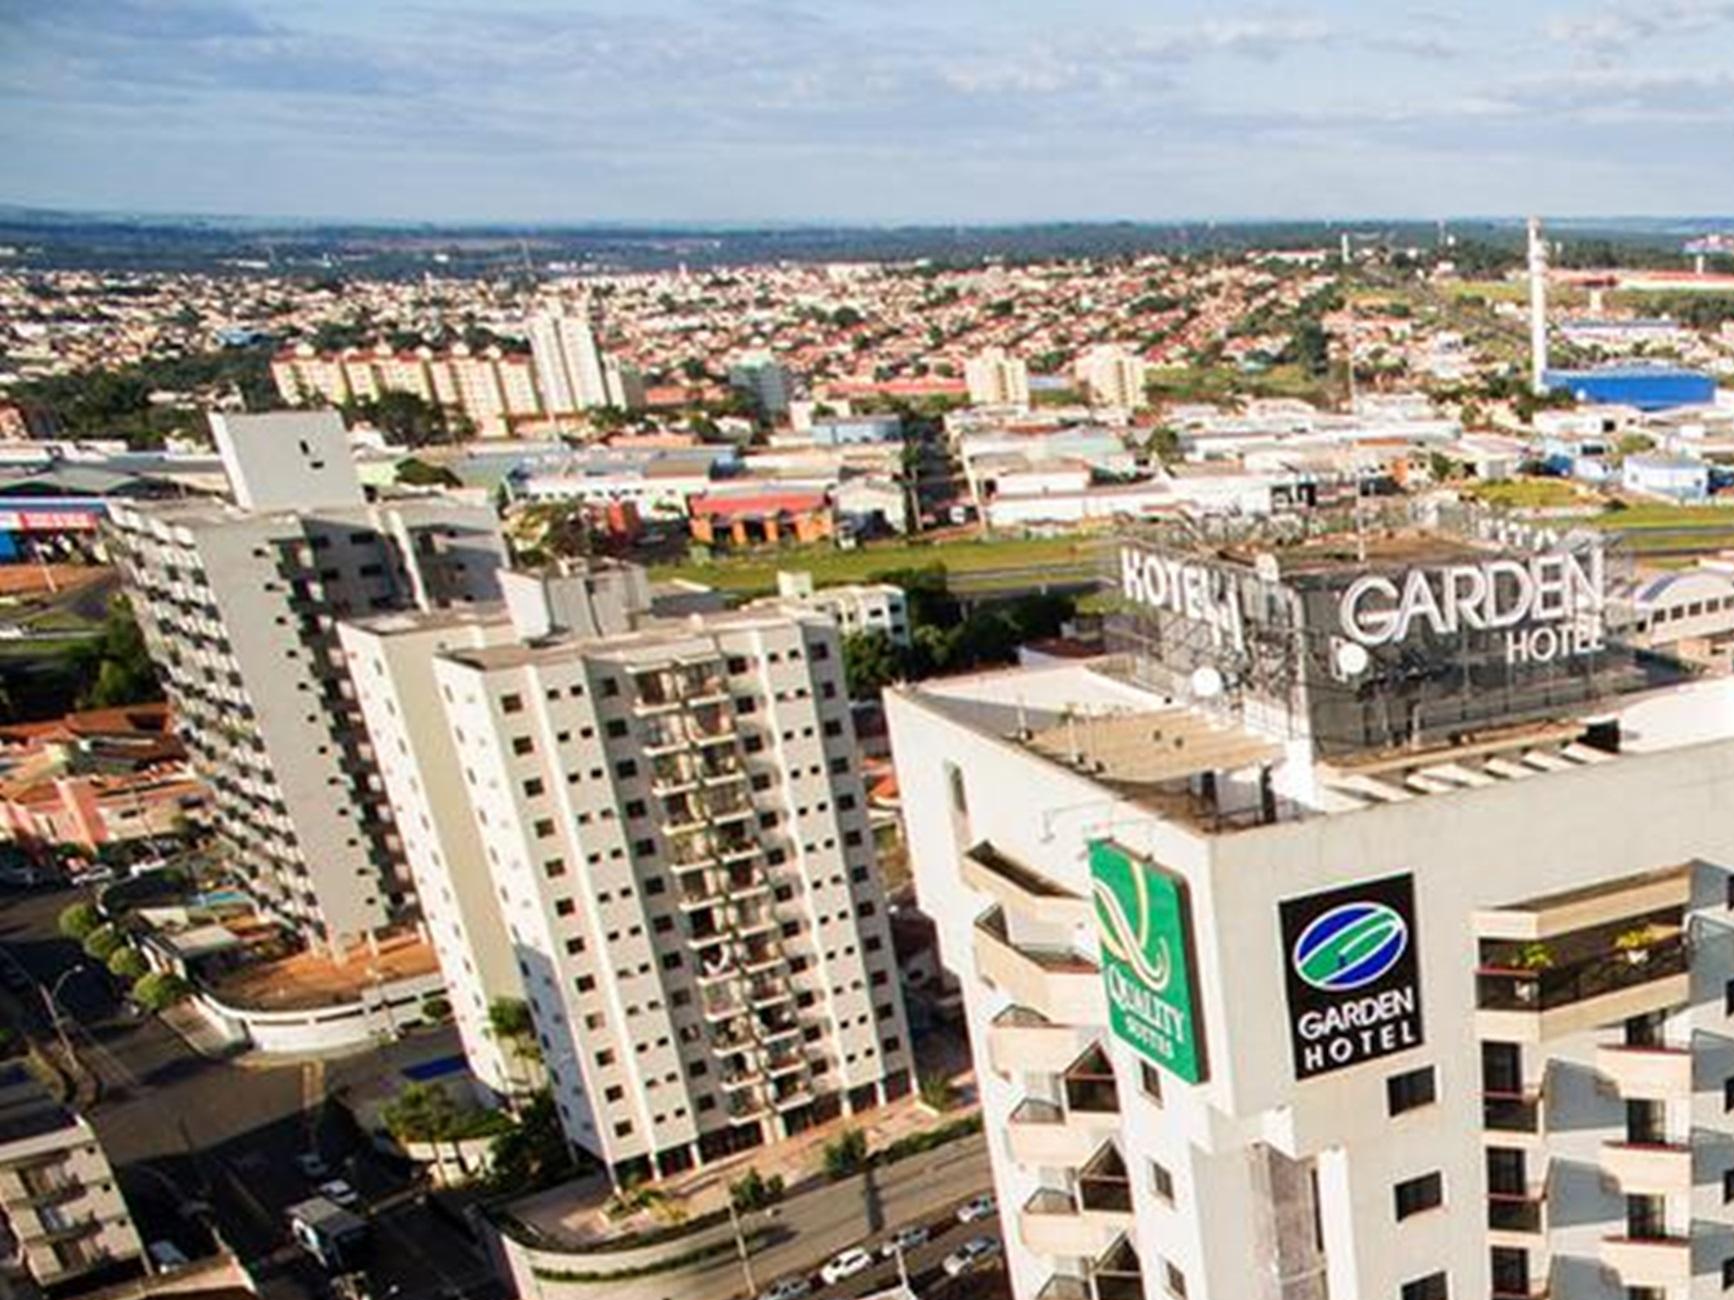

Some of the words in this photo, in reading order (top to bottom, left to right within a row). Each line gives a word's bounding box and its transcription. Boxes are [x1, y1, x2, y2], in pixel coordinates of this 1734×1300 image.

[1341, 547, 1606, 645] GARDEN
[1506, 616, 1606, 666] HOTEL
[1106, 964, 1184, 1043] QUALITY
[1298, 986, 1415, 1041] GARDEN
[1304, 1021, 1416, 1071] HOTEL
